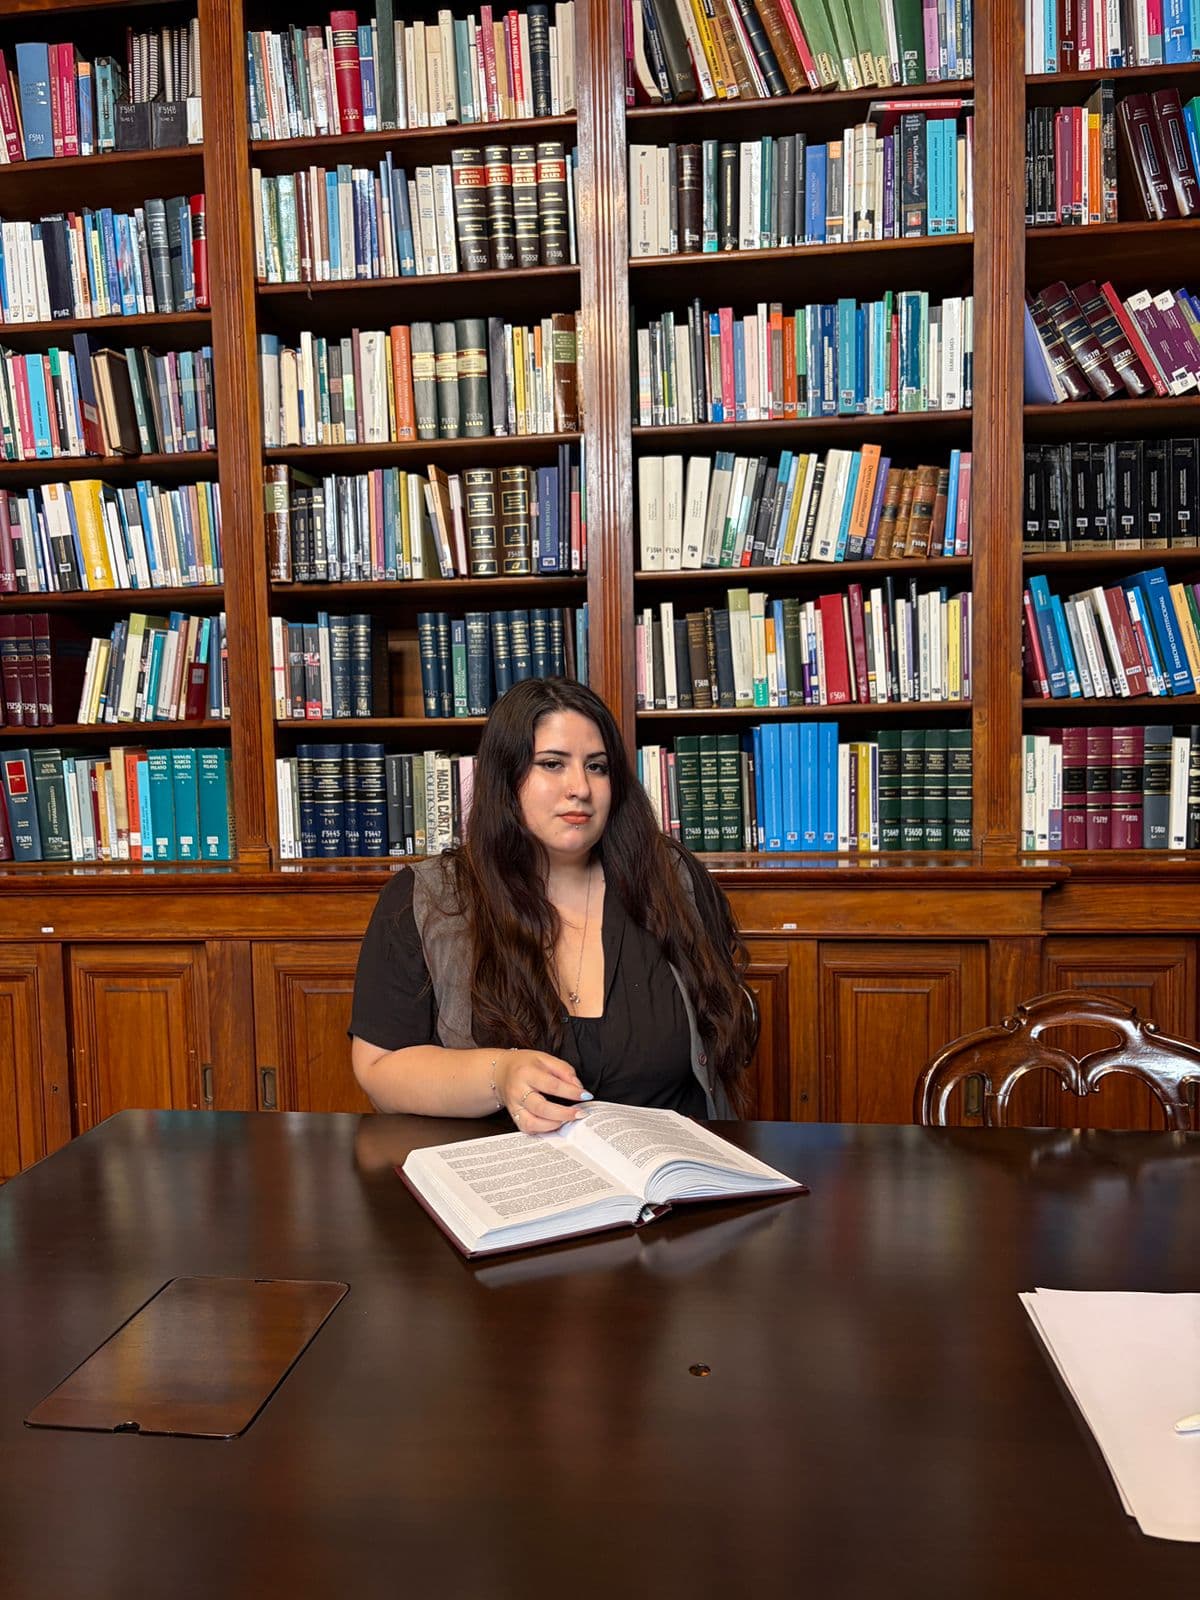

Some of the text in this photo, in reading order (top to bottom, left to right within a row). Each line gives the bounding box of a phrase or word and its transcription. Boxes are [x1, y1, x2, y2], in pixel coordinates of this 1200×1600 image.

[1159, 596, 1182, 669] DERECHO CONSTITUCIONAL
[436, 769, 450, 835] MAGNA CARTA
